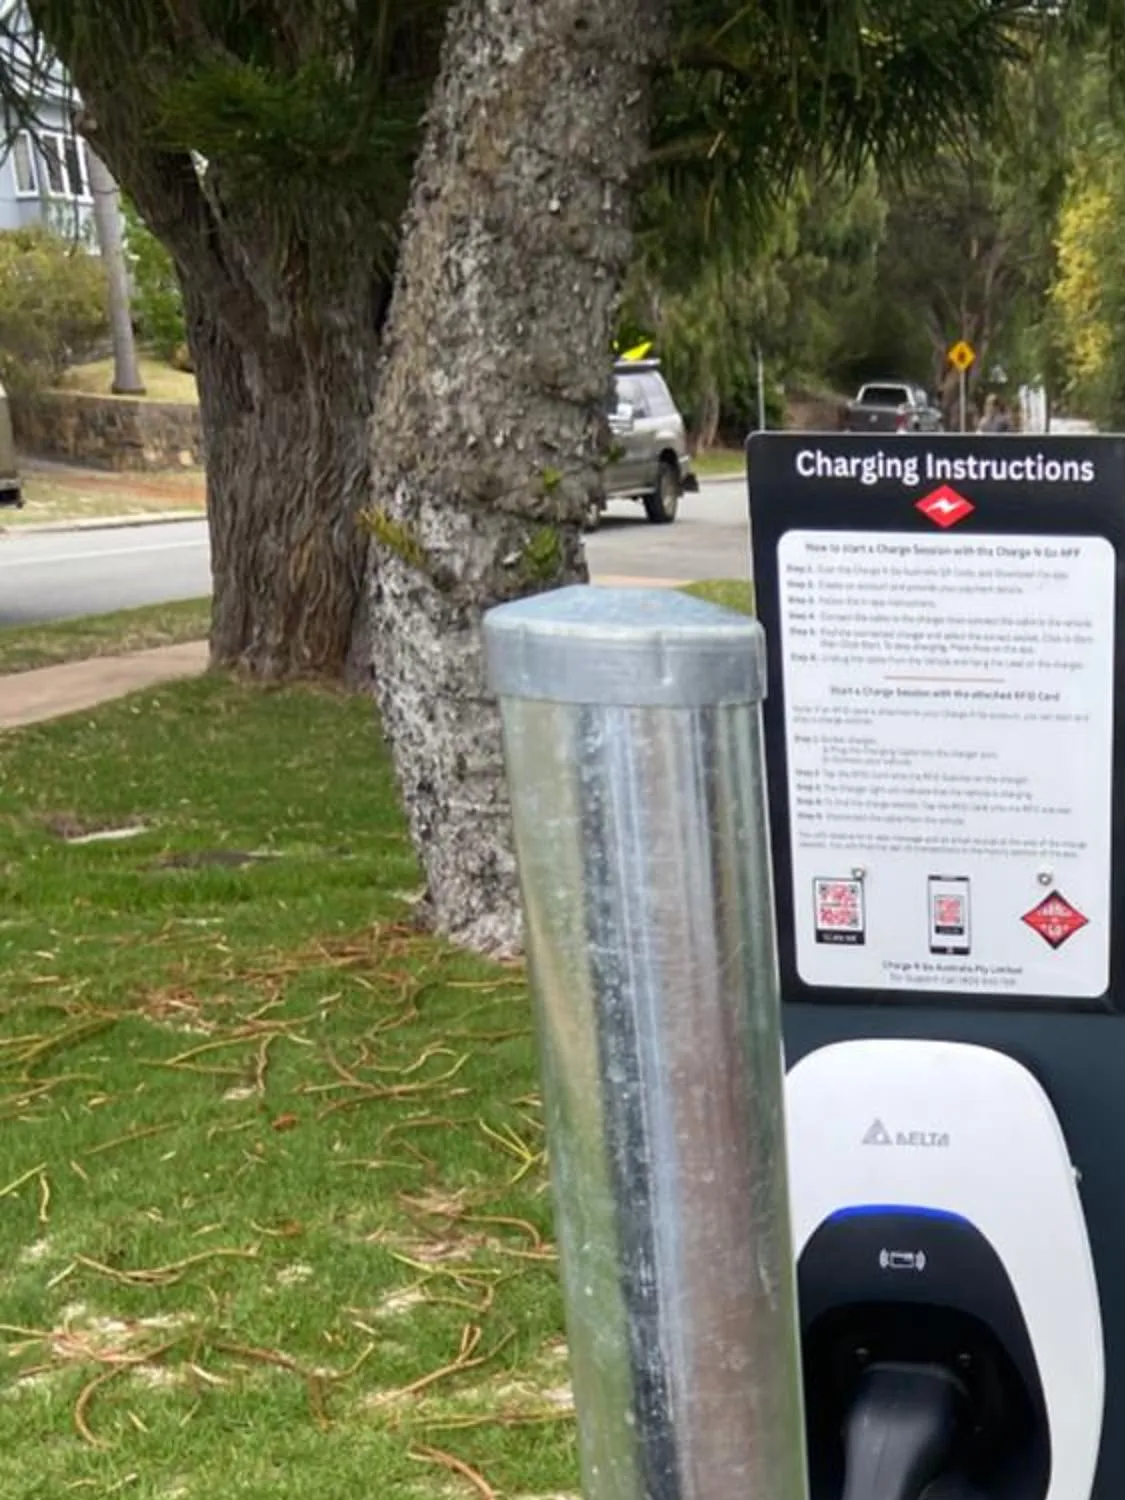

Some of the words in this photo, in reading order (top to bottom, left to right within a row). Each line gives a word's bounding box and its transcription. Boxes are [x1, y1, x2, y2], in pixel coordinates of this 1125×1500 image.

[796, 450, 920, 486] Charging
[926, 452, 1095, 482] Instructions
[876, 544, 911, 557] Charge
[996, 547, 1031, 559] Charge
[895, 1131, 950, 1147] DELTA
